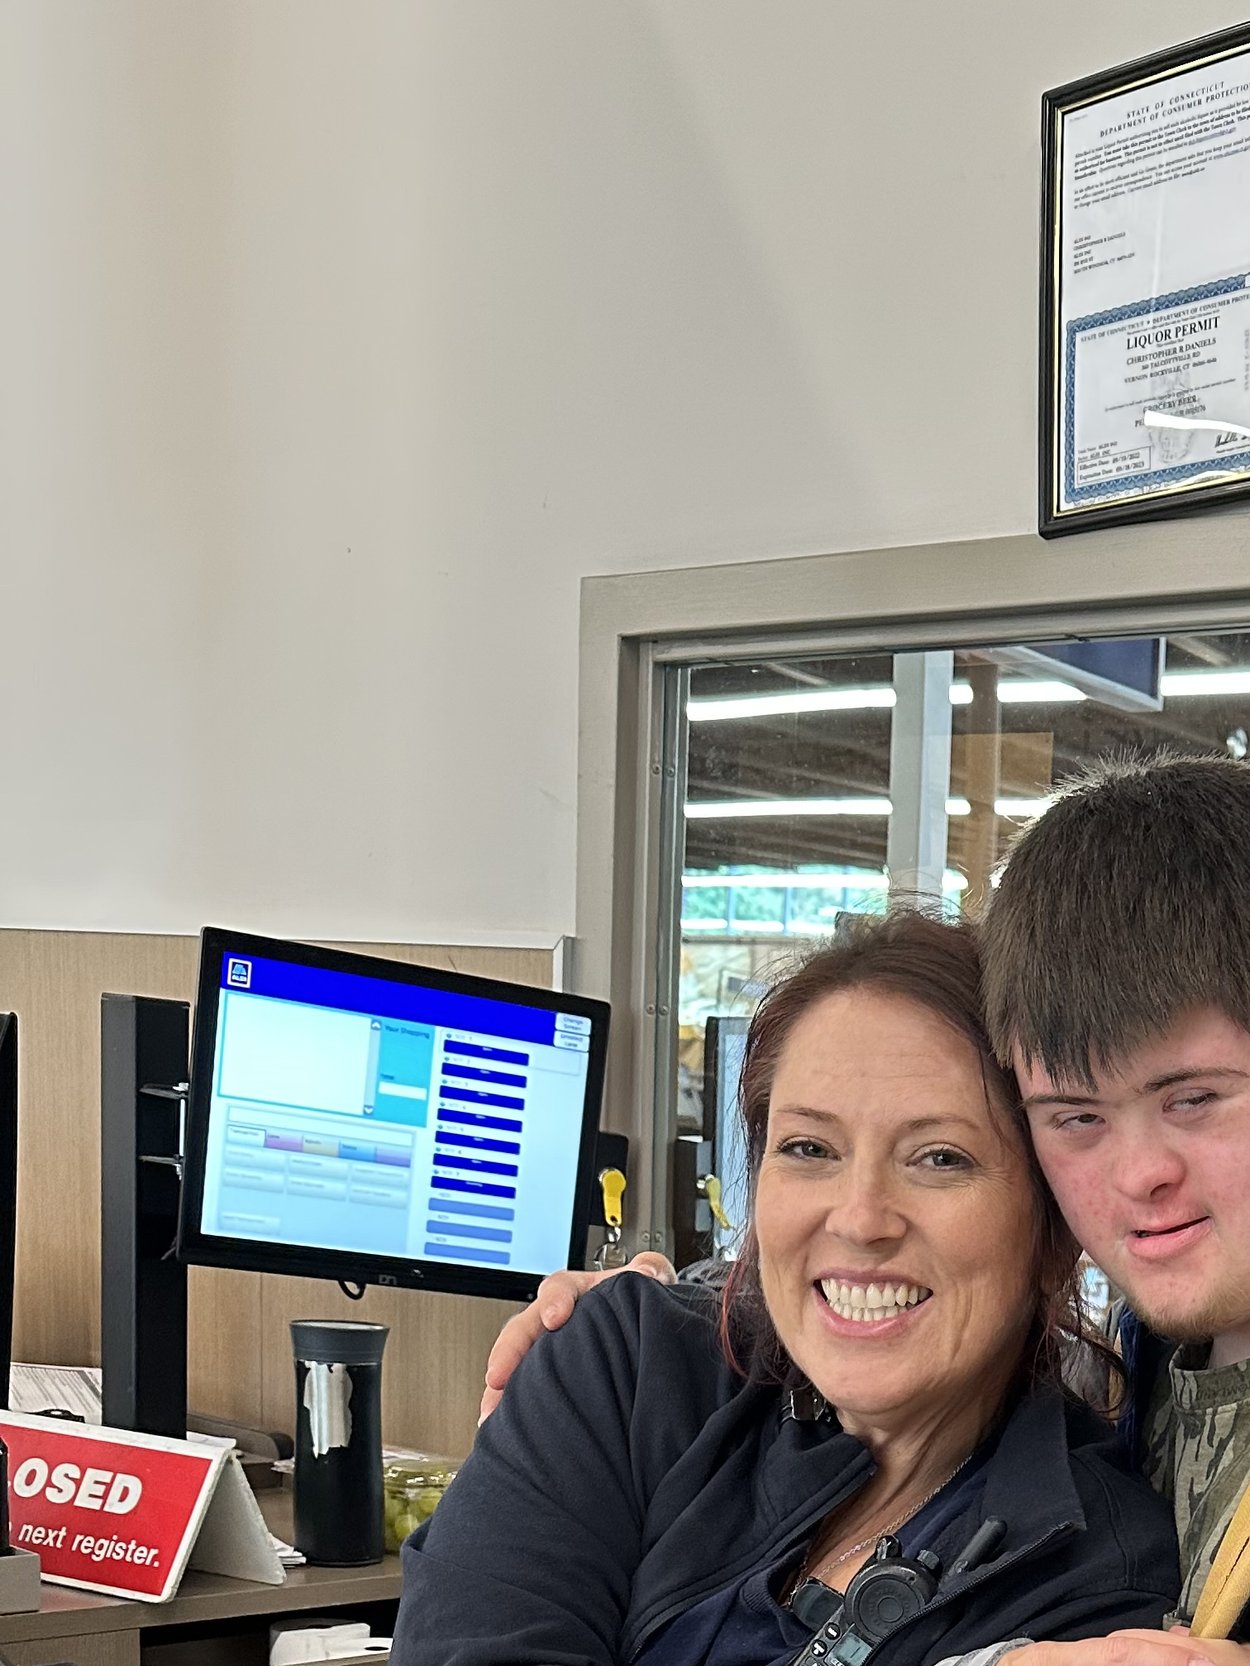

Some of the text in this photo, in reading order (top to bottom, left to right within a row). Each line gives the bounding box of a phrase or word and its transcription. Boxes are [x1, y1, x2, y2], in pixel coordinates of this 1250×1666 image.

[1100, 116, 1146, 138] DEPARTMENT
[1149, 112, 1158, 122] OF
[1162, 97, 1202, 118] CONSUMER
[1127, 80, 1224, 119] STATE OF CONNECTICUT
[1080, 332, 1096, 342] STATE
[1106, 320, 1144, 336] CONNECTICUT
[1152, 309, 1188, 324] DEPARTMENT
[1190, 306, 1197, 314] OF
[1199, 298, 1230, 312] CONSUMER
[1126, 328, 1172, 350] LIQUOR
[1175, 316, 1220, 339] PERMIT
[1126, 347, 1178, 366] CHRISTOPHER
[1185, 338, 1217, 352] DANIELS
[1124, 374, 1148, 384] VERNON
[400, 1026, 430, 1039] Shopping
[13, 1457, 143, 1514] OSED
[18, 1524, 159, 1568] next register.
